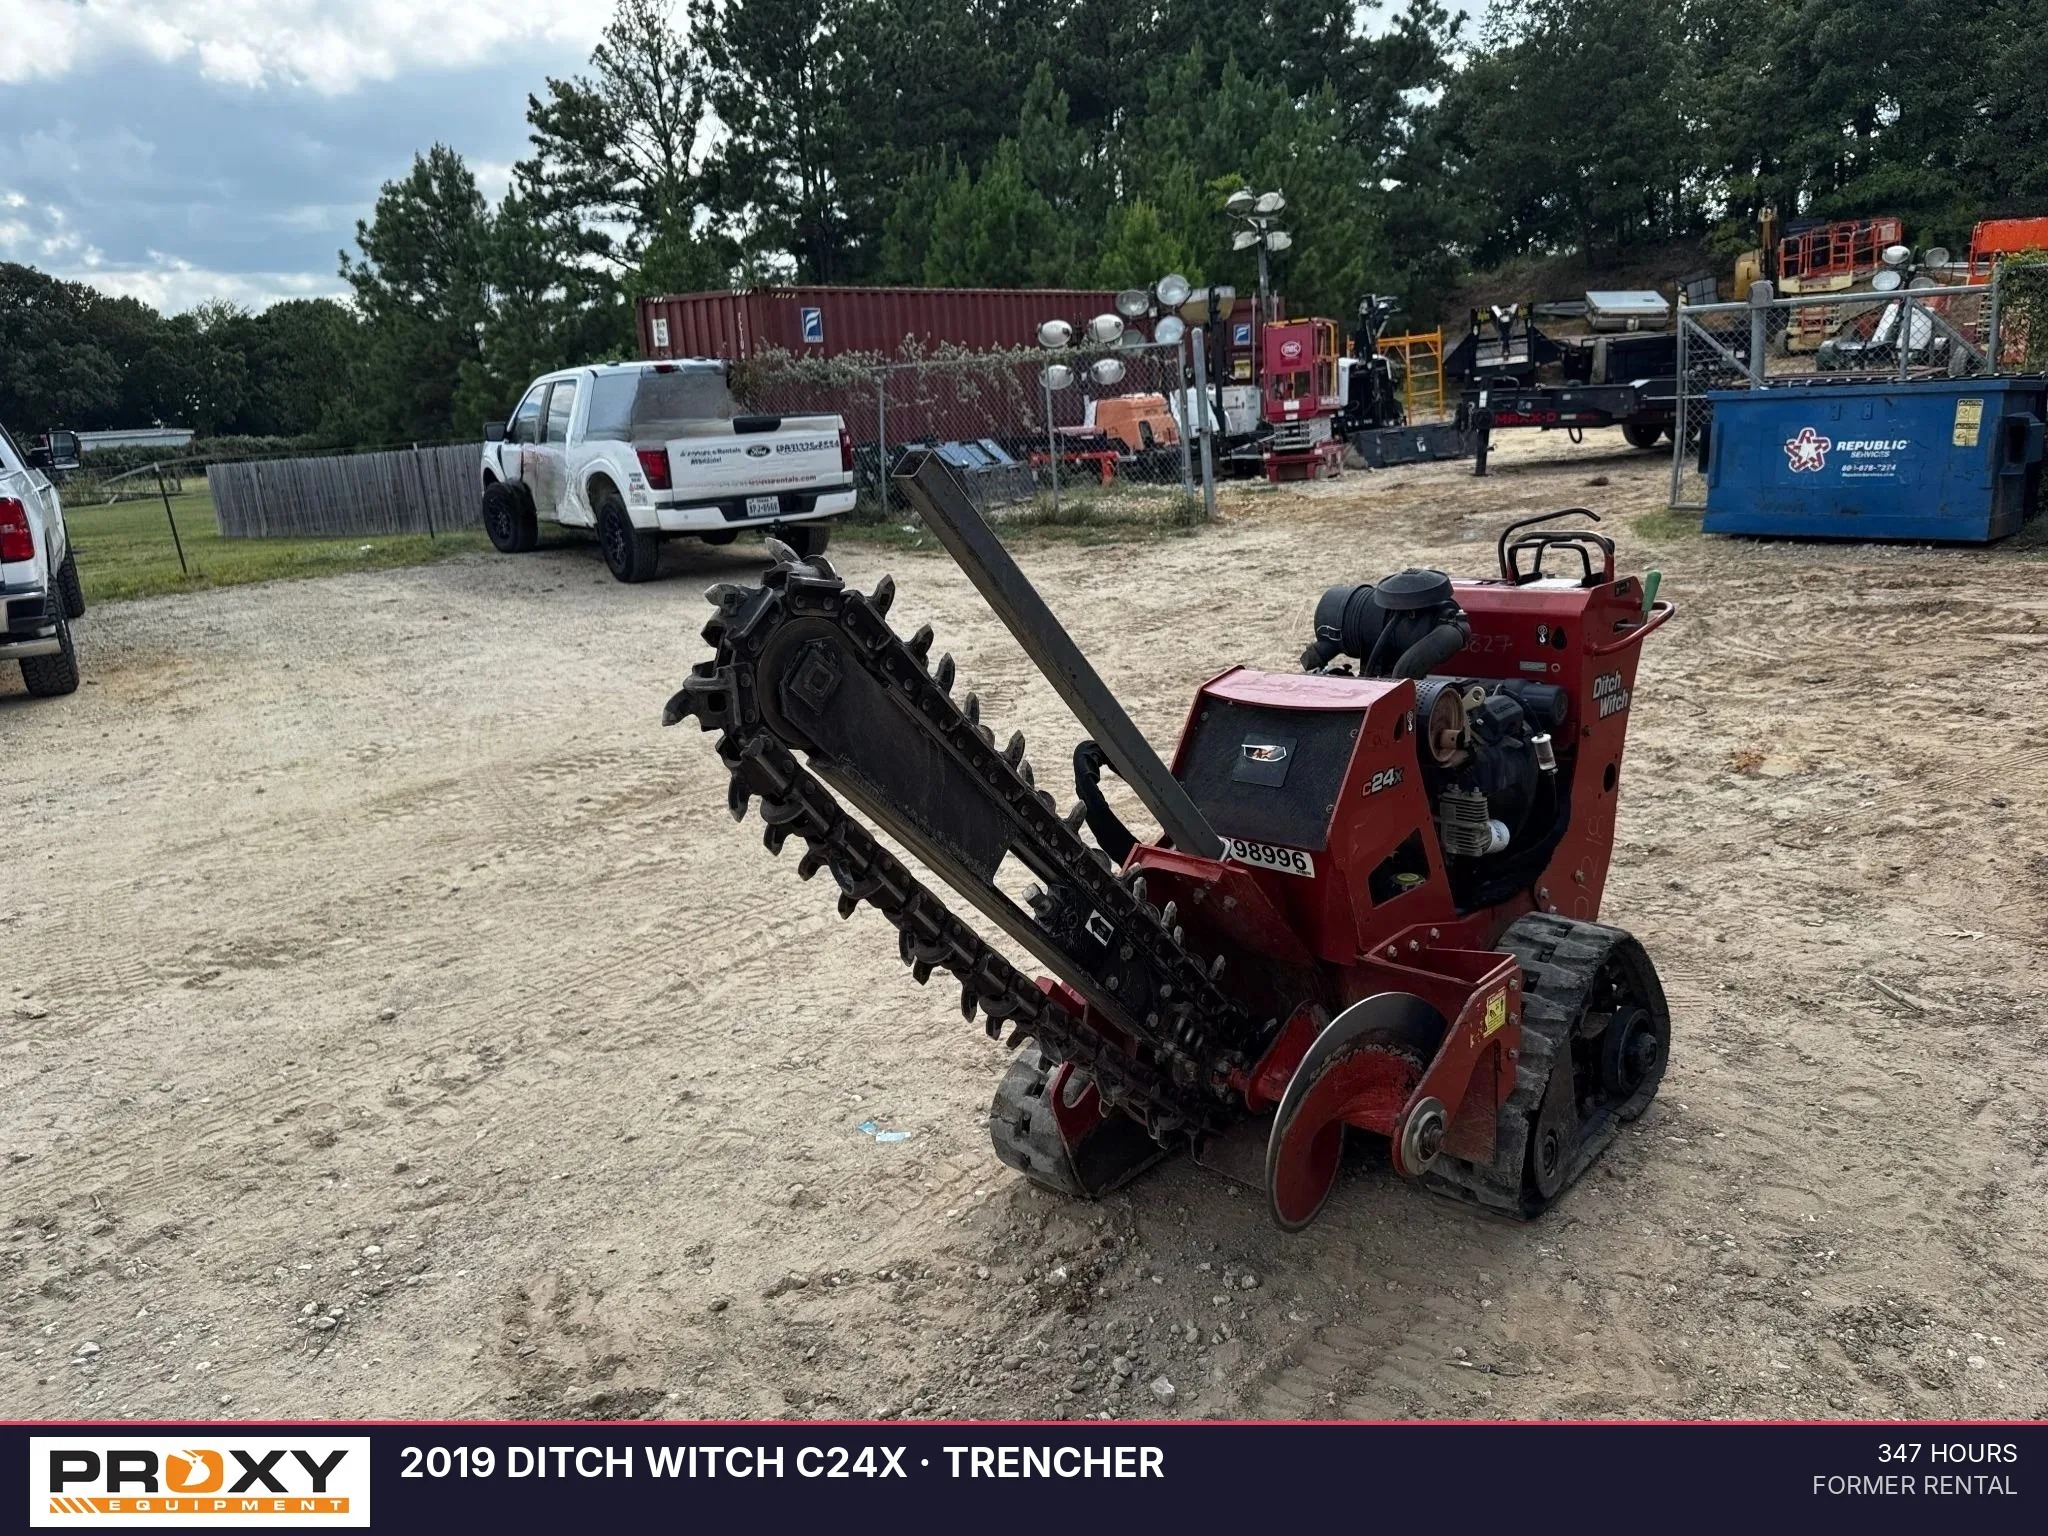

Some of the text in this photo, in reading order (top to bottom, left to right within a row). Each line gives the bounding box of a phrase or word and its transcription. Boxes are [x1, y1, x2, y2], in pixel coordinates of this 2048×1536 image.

[750, 448, 767, 457] Ford
[1836, 440, 1908, 451] REPUBLIC
[1593, 670, 1622, 699] Ditch
[1599, 689, 1628, 718] Witch
